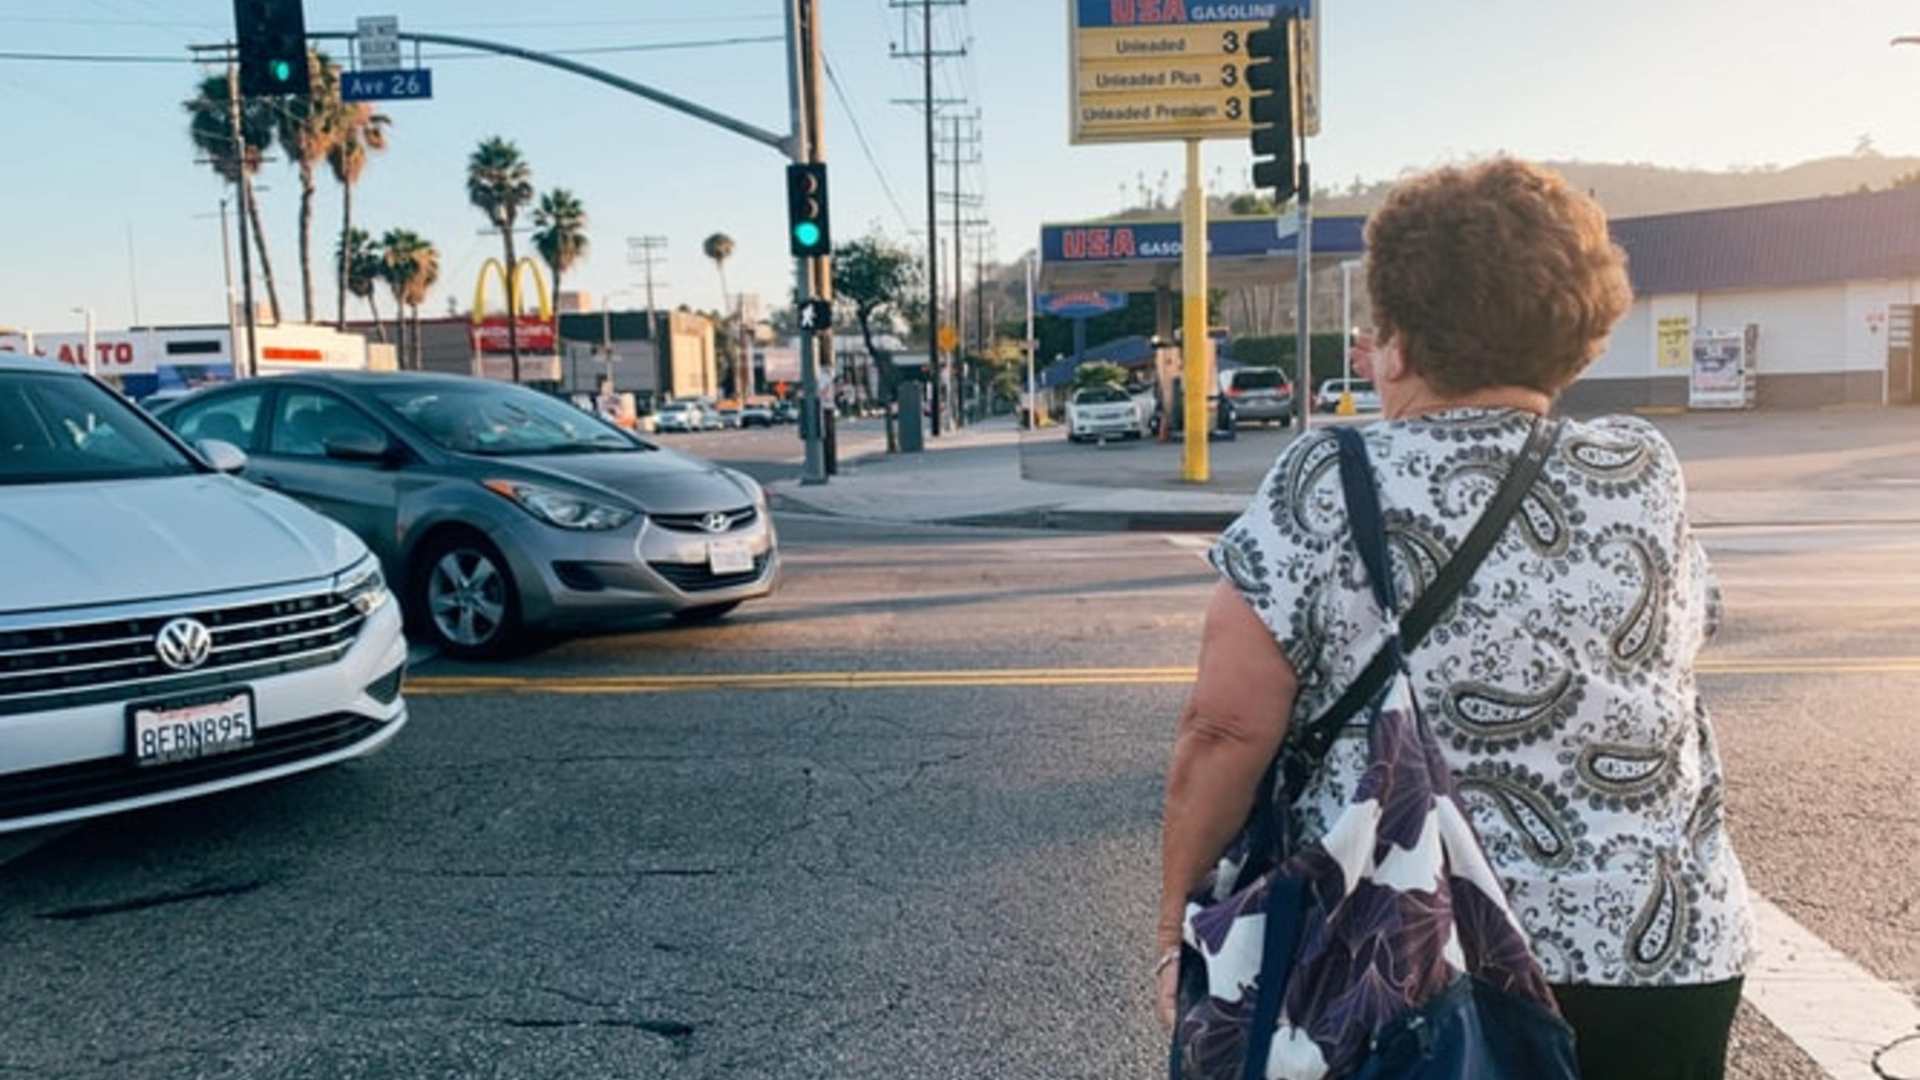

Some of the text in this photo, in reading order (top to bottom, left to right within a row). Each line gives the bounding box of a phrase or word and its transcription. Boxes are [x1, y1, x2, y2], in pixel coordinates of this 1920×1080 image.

[1111, 0, 1274, 24] USA GASOLINE
[1117, 31, 1239, 54] Unleaded 3
[351, 75, 420, 95] Ave 26
[1097, 64, 1238, 87] Unleaded Plus 3
[1082, 97, 1242, 121] Unleaded Premium 3
[1063, 229, 1135, 258] USA
